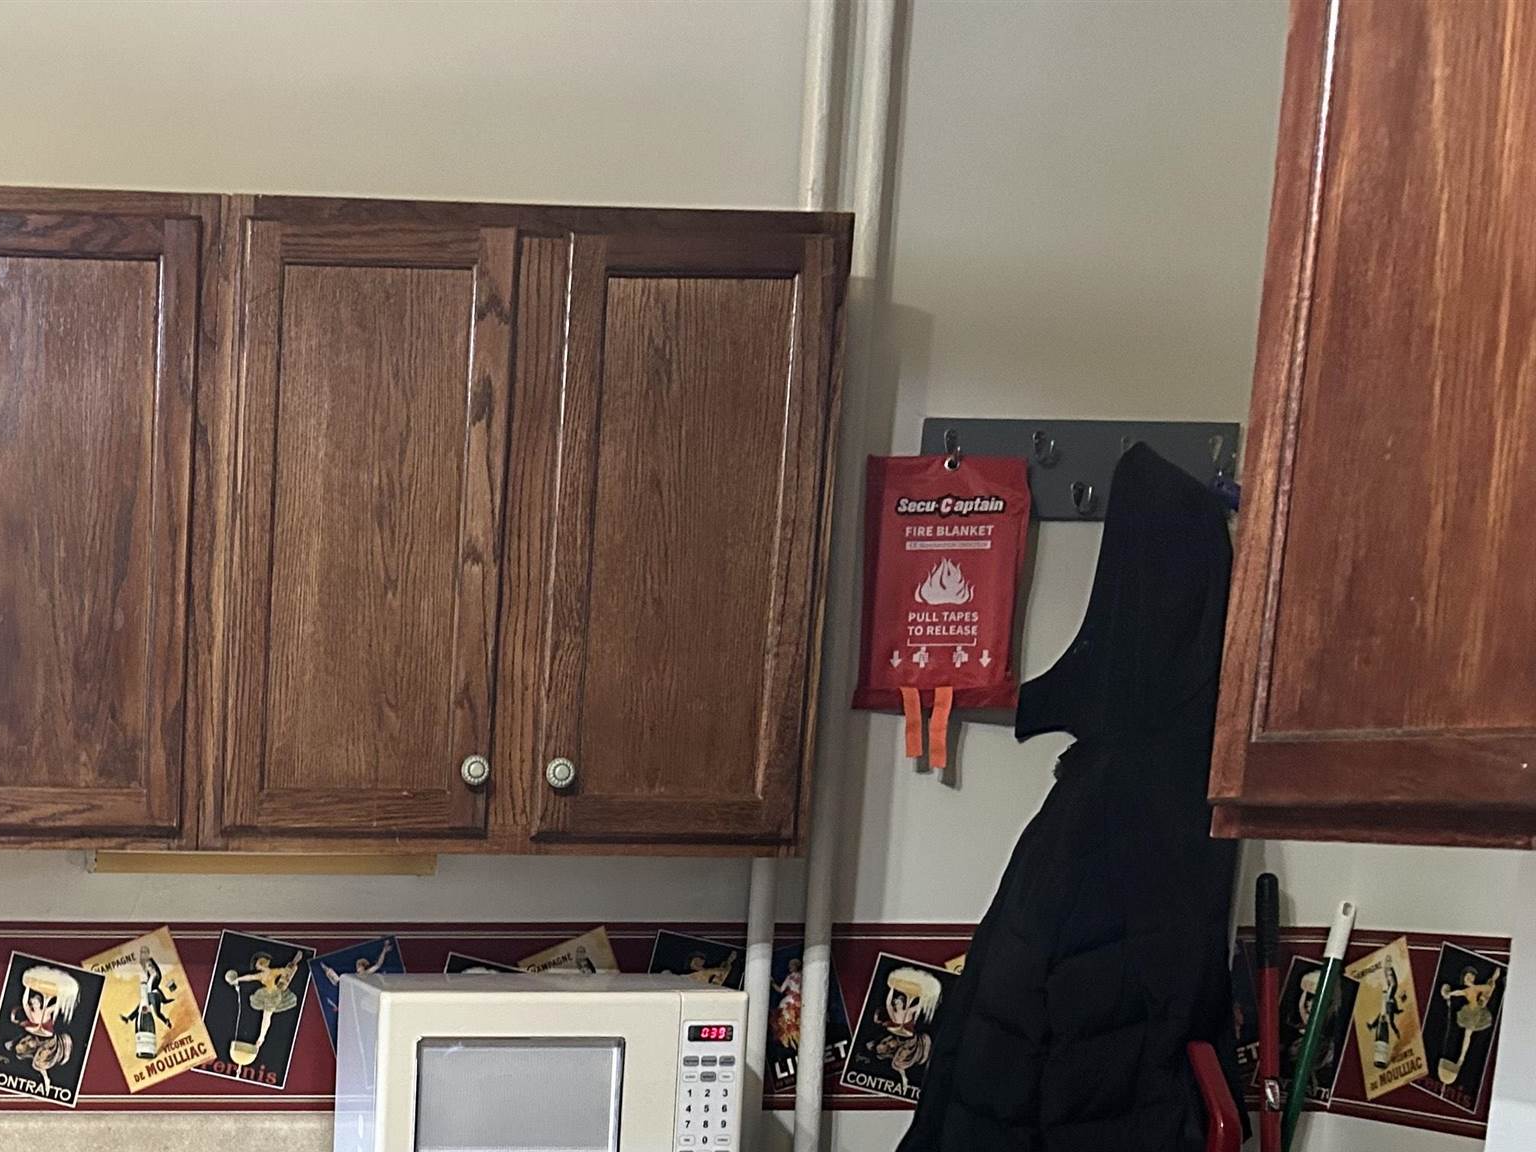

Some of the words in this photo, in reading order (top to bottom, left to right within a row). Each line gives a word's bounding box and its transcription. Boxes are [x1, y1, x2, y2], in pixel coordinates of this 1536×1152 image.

[905, 526, 933, 537] FIRE
[936, 525, 994, 536] BLANKET
[908, 612, 939, 622] PULL
[942, 611, 979, 622] TAPES
[907, 626, 923, 636] TO
[926, 625, 978, 636] RELEASE
[134, 1072, 146, 1083] DE
[145, 1042, 207, 1077] MOULLIAC
[774, 1040, 848, 1079] LIET
[687, 1089, 692, 1097] 1
[704, 1089, 711, 1097] 2
[722, 1089, 728, 1097] 3
[685, 1105, 692, 1113] 4
[703, 1105, 710, 1113] 5
[721, 1105, 728, 1113] 6
[685, 1120, 691, 1129] 7
[703, 1120, 709, 1129] 8
[721, 1120, 727, 1129] 9
[702, 1136, 708, 1144] 0
